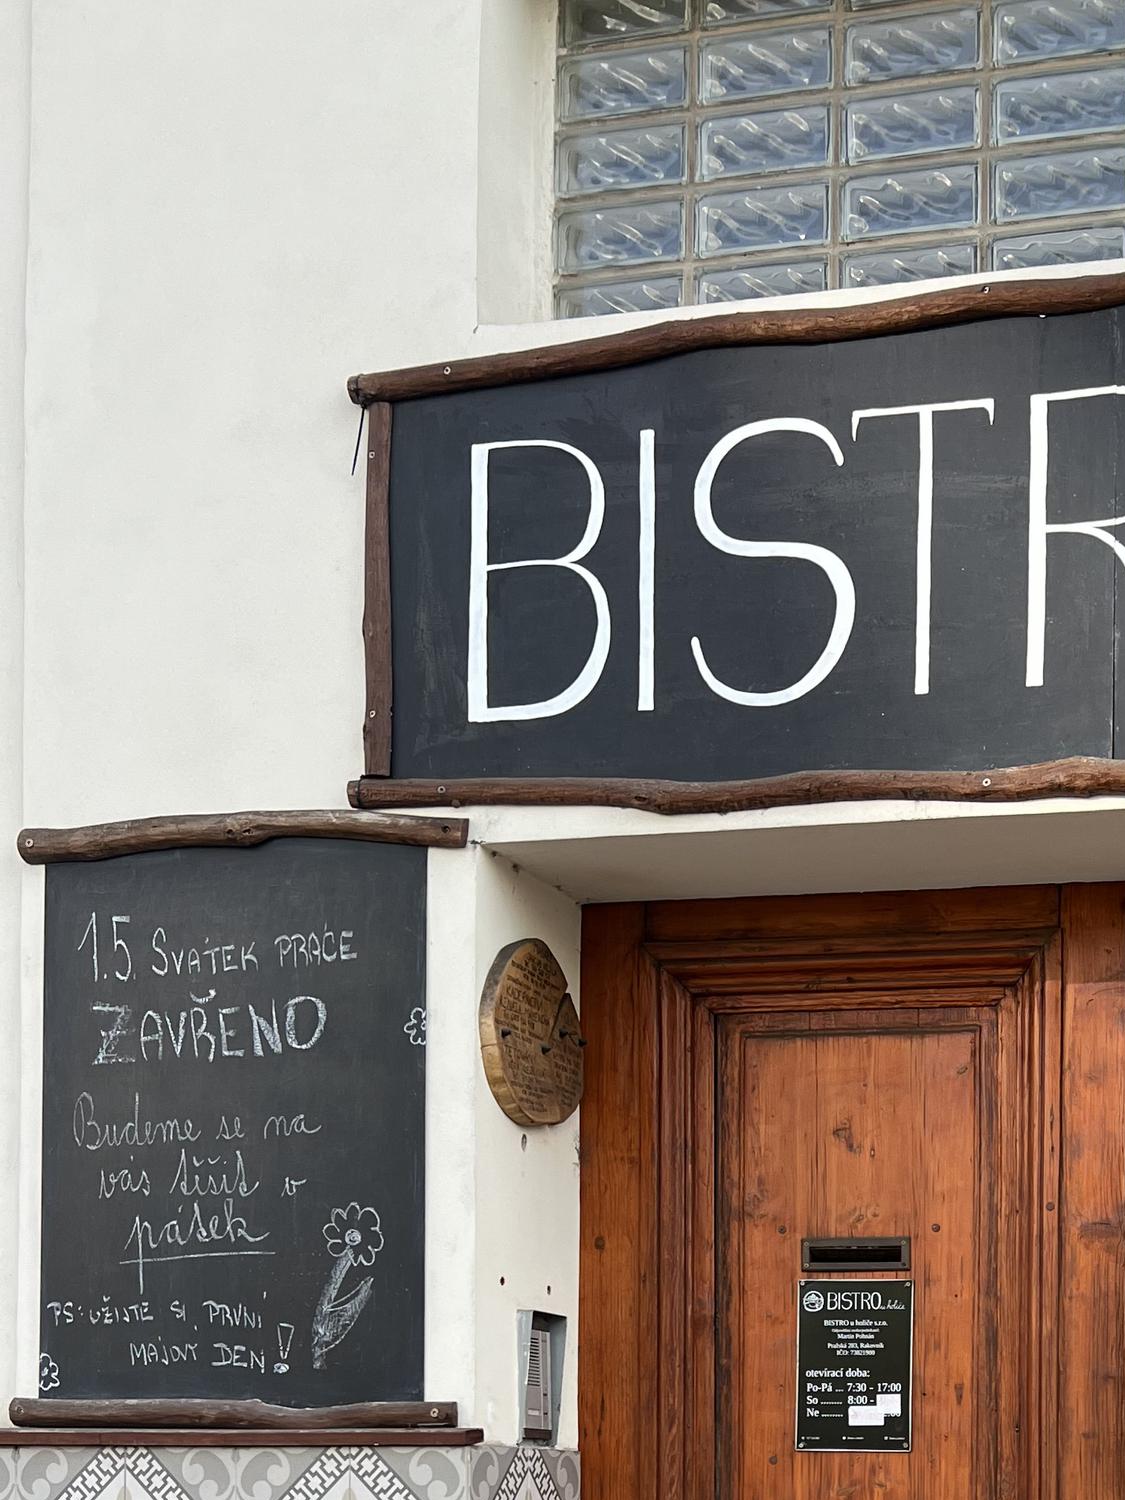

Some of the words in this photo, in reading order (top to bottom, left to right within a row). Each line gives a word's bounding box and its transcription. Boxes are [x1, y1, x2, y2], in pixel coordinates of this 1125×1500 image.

[91, 988, 328, 1066] ZAVŘENO
[73, 1091, 202, 1151] Budeme
[216, 1115, 246, 1140] se
[263, 1113, 322, 1140] na
[98, 1155, 150, 1199] vás
[169, 1148, 260, 1197] těšit
[281, 1176, 307, 1197] v
[124, 1198, 271, 1295] pátek
[170, 1300, 188, 1322] SI
[203, 1291, 263, 1329] PRVNÍ
[826, 1291, 881, 1310] BISTRO
[824, 1319, 850, 1327] BISTRO
[129, 1325, 199, 1366] MÁJOVÝ
[805, 1368, 844, 1378] otevírací
[845, 1367, 871, 1378] doba:
[806, 1382, 833, 1392] Po-Pá
[847, 1383, 867, 1392] 7:30
[877, 1383, 901, 1392] 17:00
[806, 1395, 819, 1405] So
[847, 1395, 868, 1405] 8:00
[806, 1408, 820, 1417] Ne
